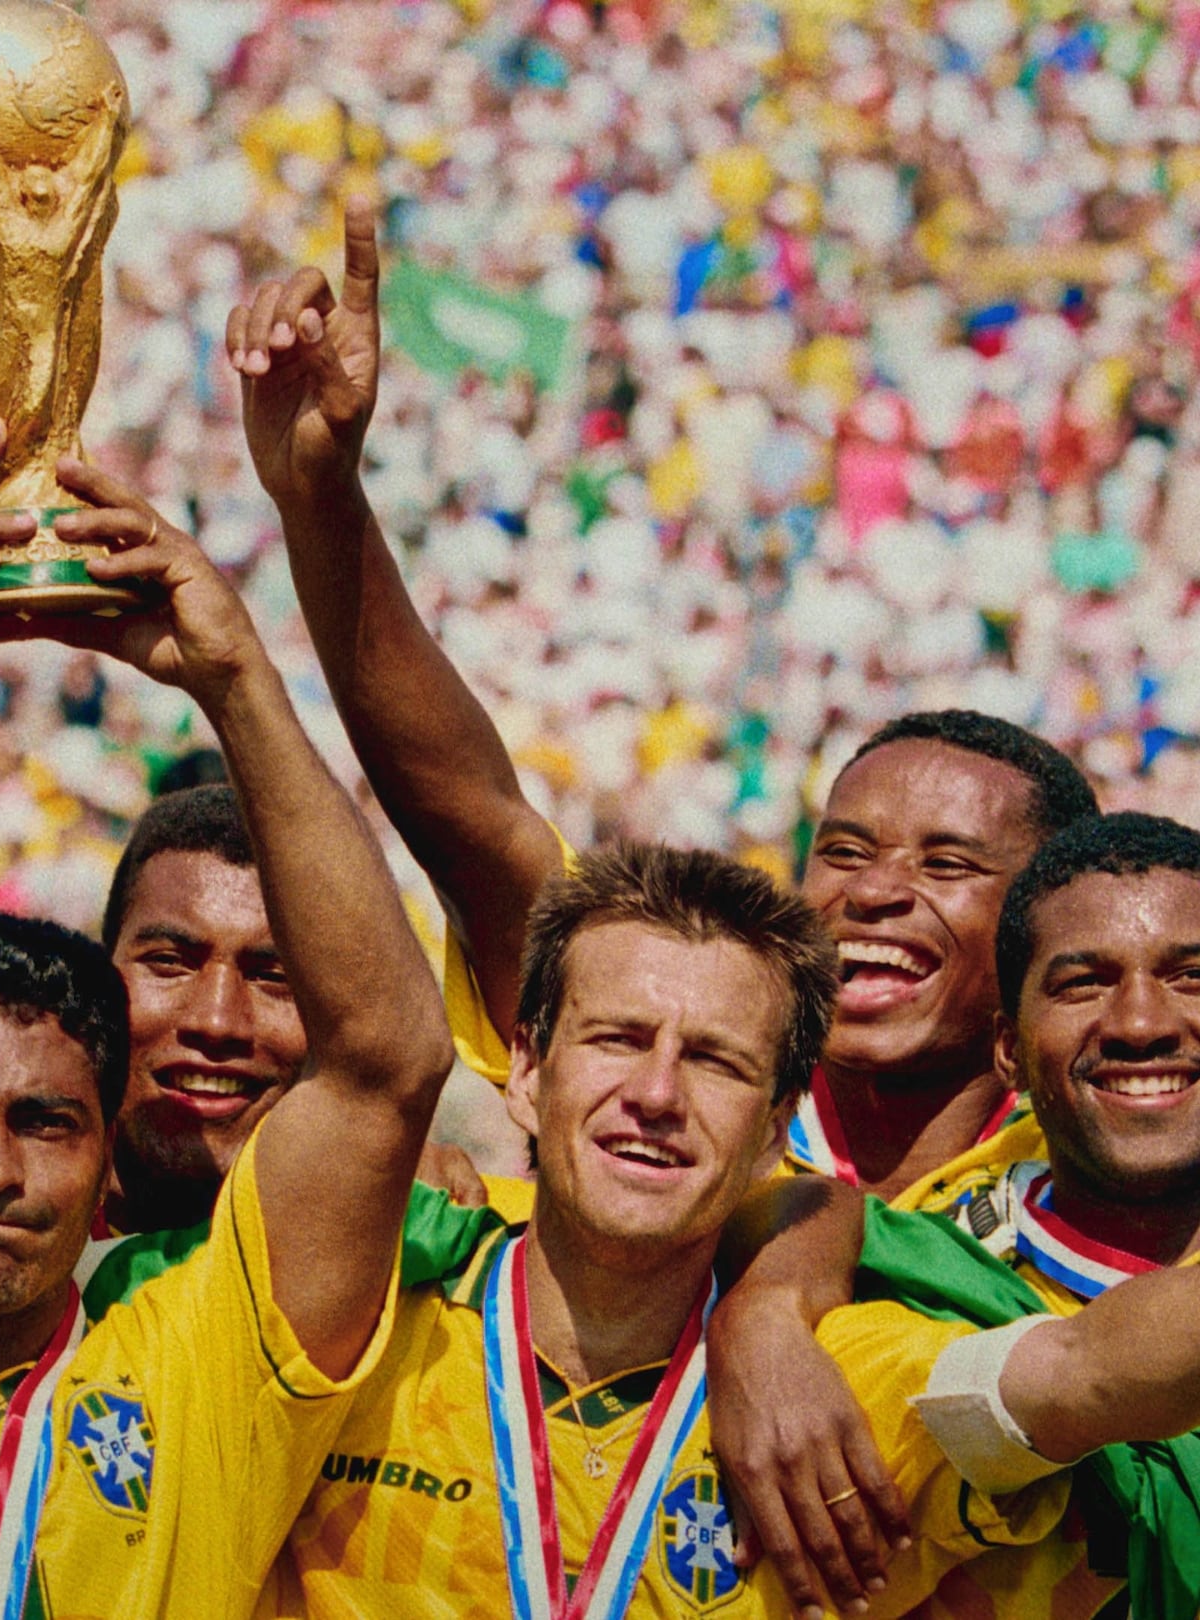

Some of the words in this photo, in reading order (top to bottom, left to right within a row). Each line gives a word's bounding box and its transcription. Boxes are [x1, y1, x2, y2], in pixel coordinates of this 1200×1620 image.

[99, 1436, 131, 1461] CBF
[321, 1453, 472, 1502] UMBRO
[685, 1525, 721, 1545] CBF
